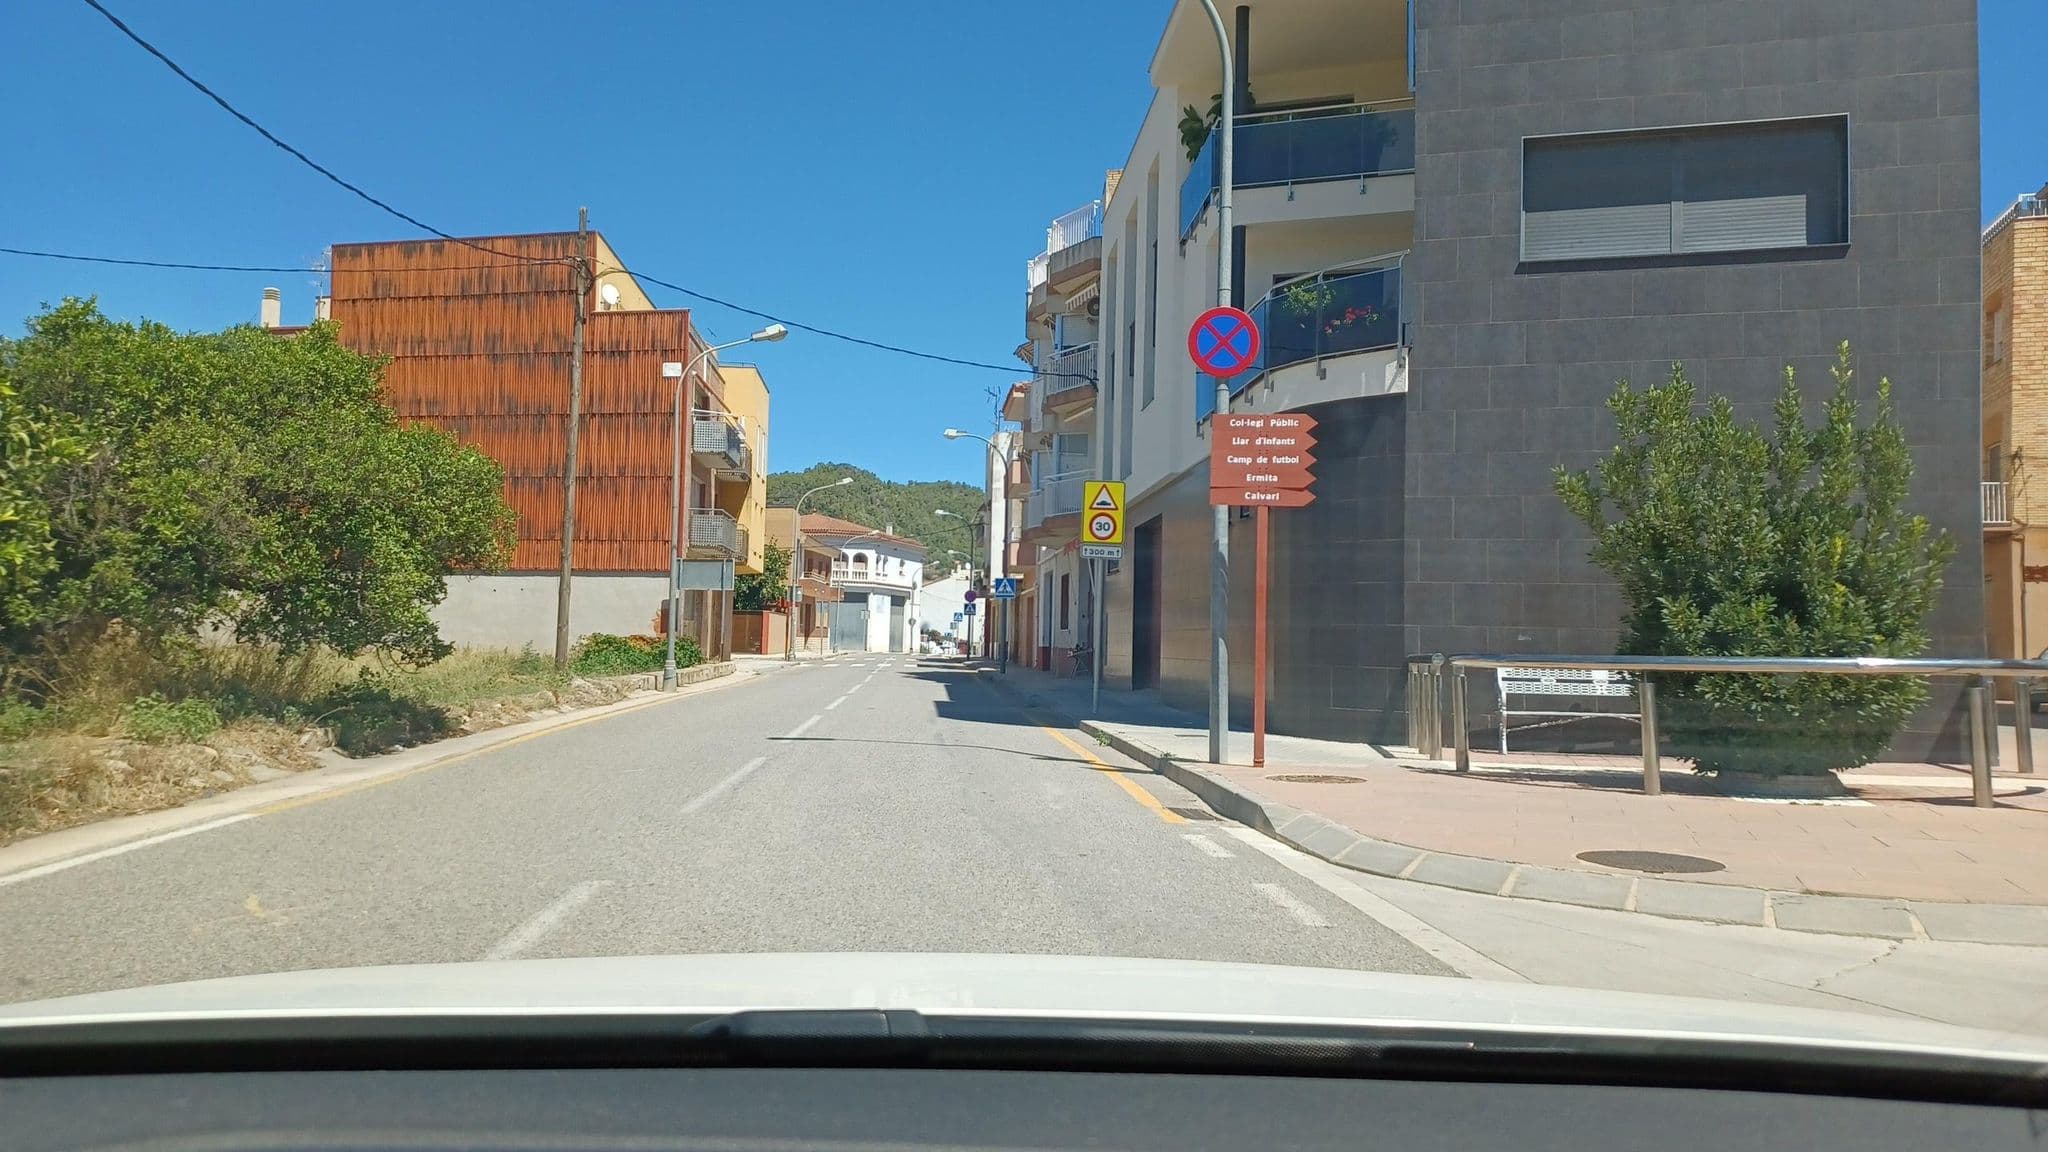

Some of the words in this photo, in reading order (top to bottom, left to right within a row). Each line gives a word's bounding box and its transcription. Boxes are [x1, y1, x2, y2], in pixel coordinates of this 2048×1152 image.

[1270, 419, 1299, 427] Públic
[1232, 437, 1249, 446] Llar
[1255, 437, 1295, 446] d'infants
[1227, 455, 1252, 465] Camp
[1256, 456, 1268, 464] de
[1272, 456, 1299, 464] futbol
[1246, 474, 1278, 482] Ermita
[1244, 492, 1280, 501] Calvari
[1095, 522, 1111, 532] 30
